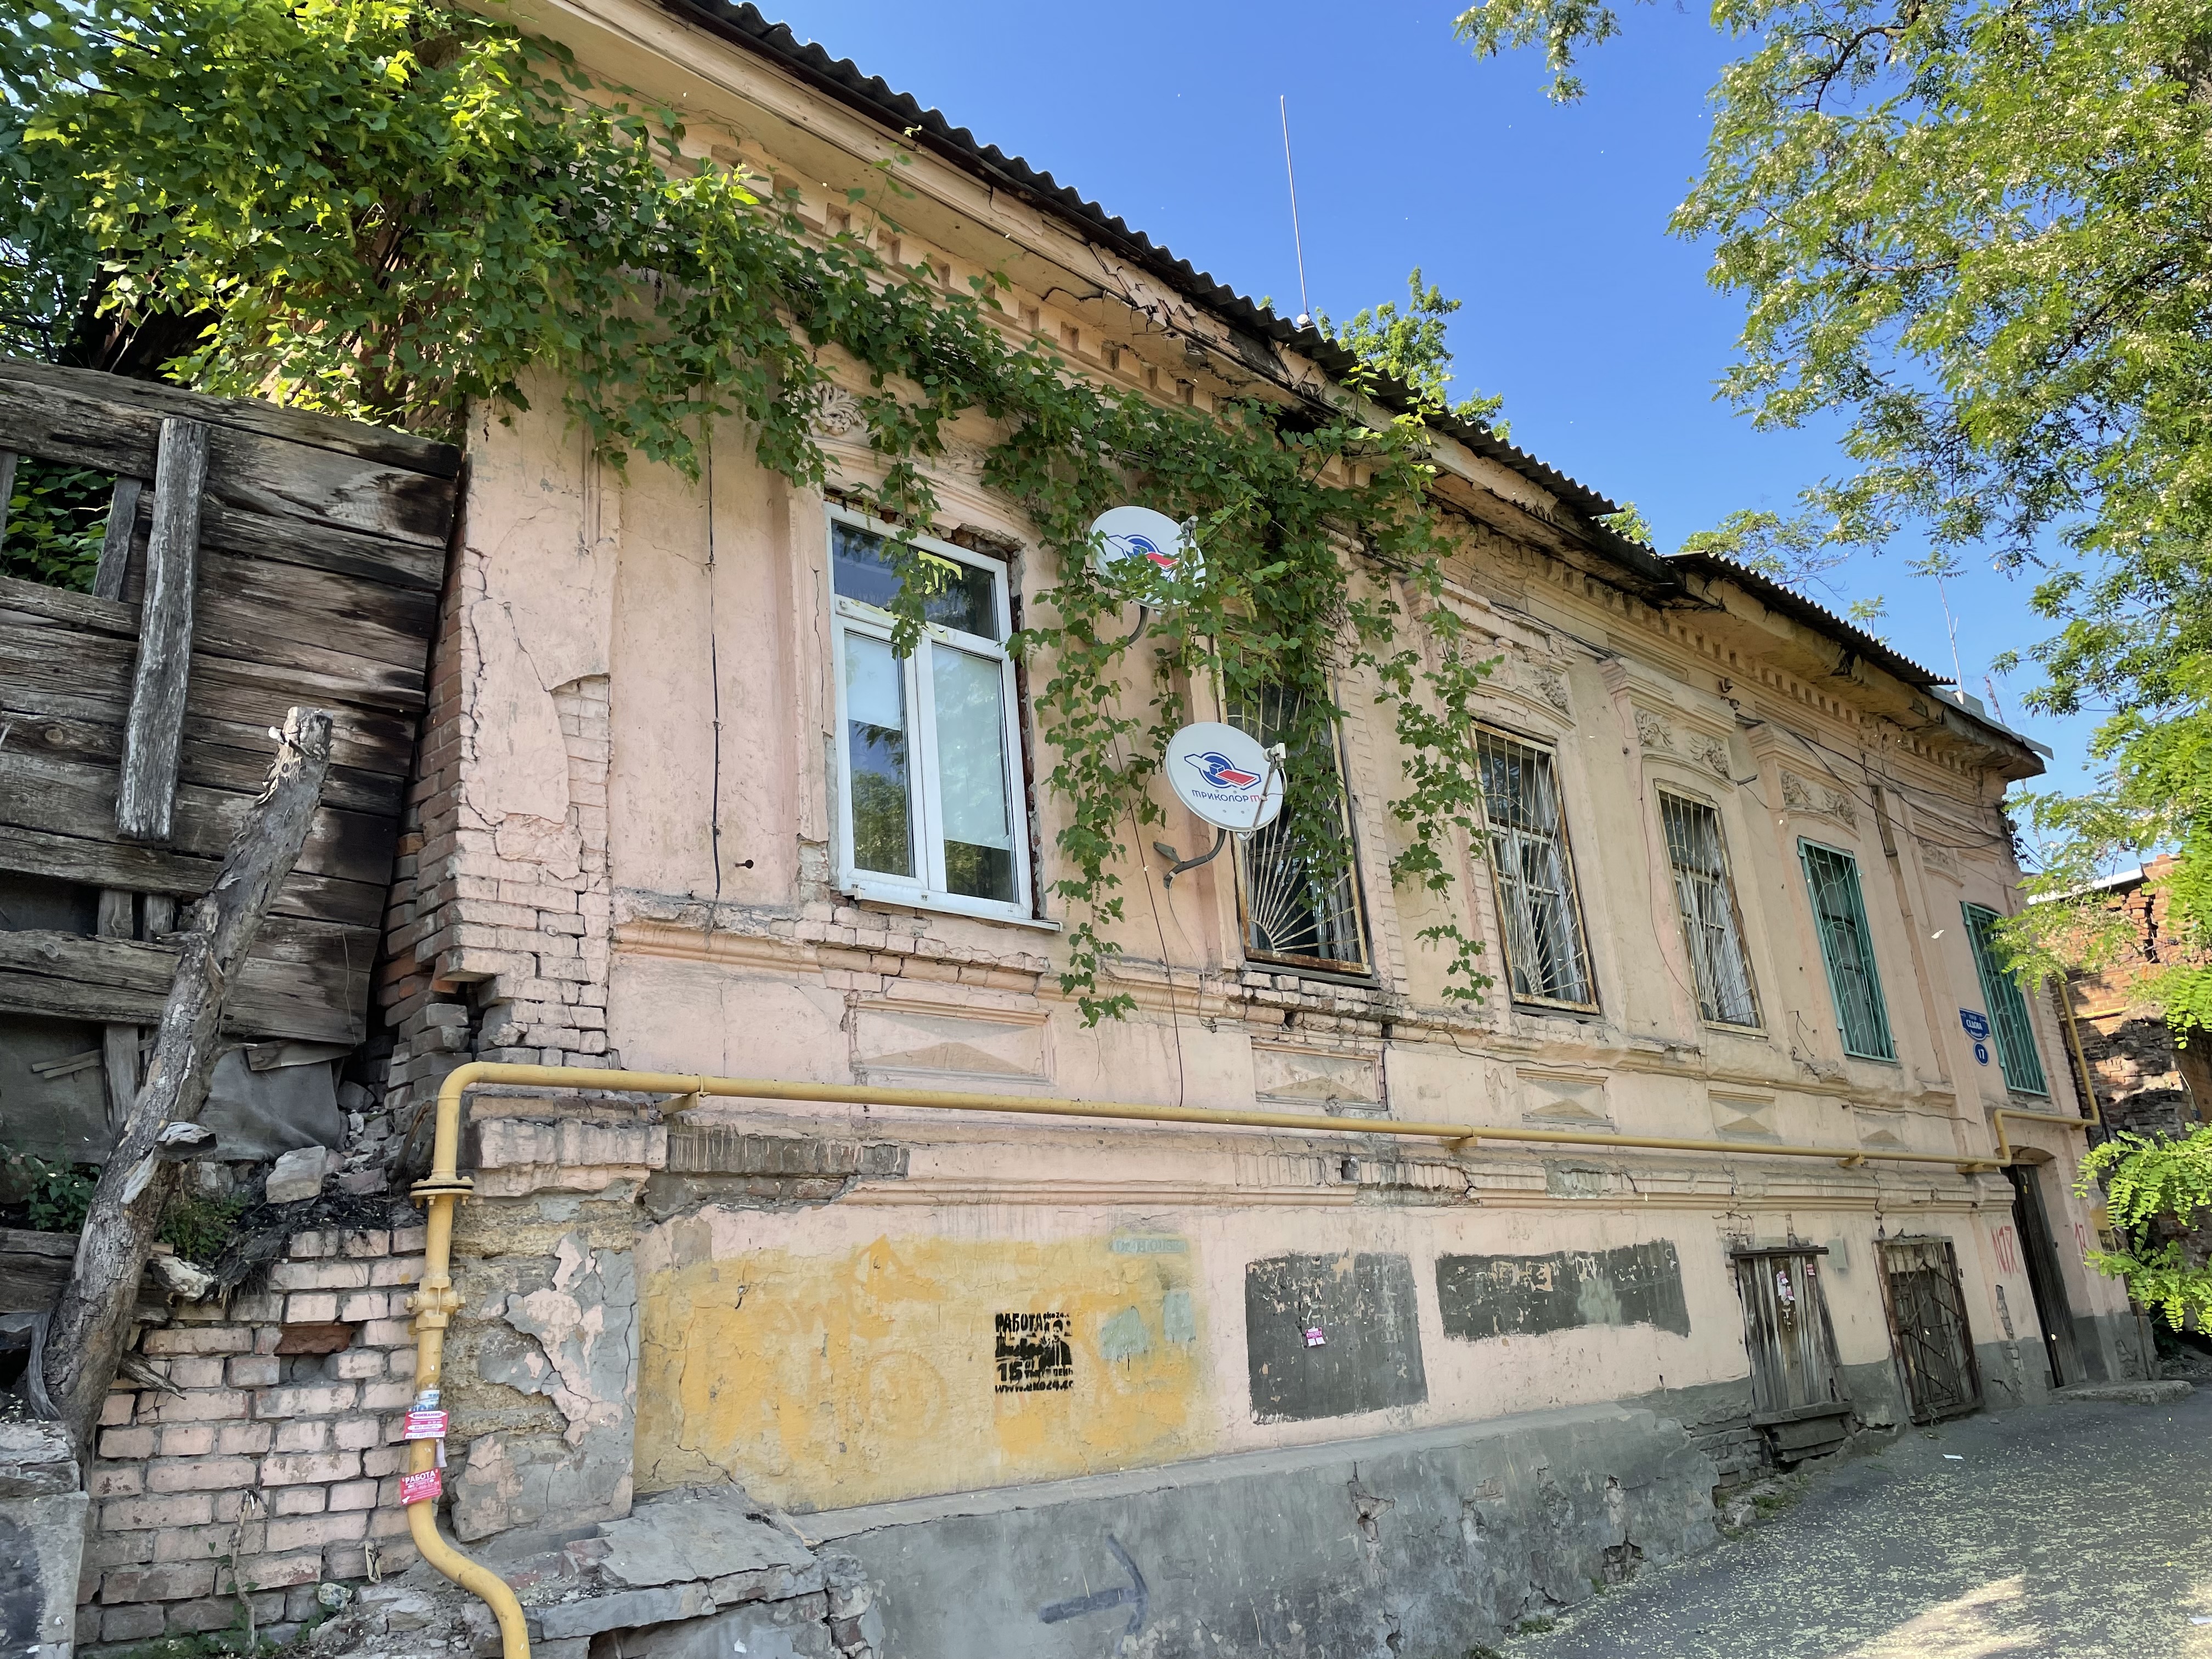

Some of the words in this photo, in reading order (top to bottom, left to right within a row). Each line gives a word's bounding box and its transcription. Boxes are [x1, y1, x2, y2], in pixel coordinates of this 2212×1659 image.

[1978, 1048, 1985, 1059] 17
[995, 1312, 1042, 1333] РАБОТА
[405, 1470, 436, 1484] РАБОТА
